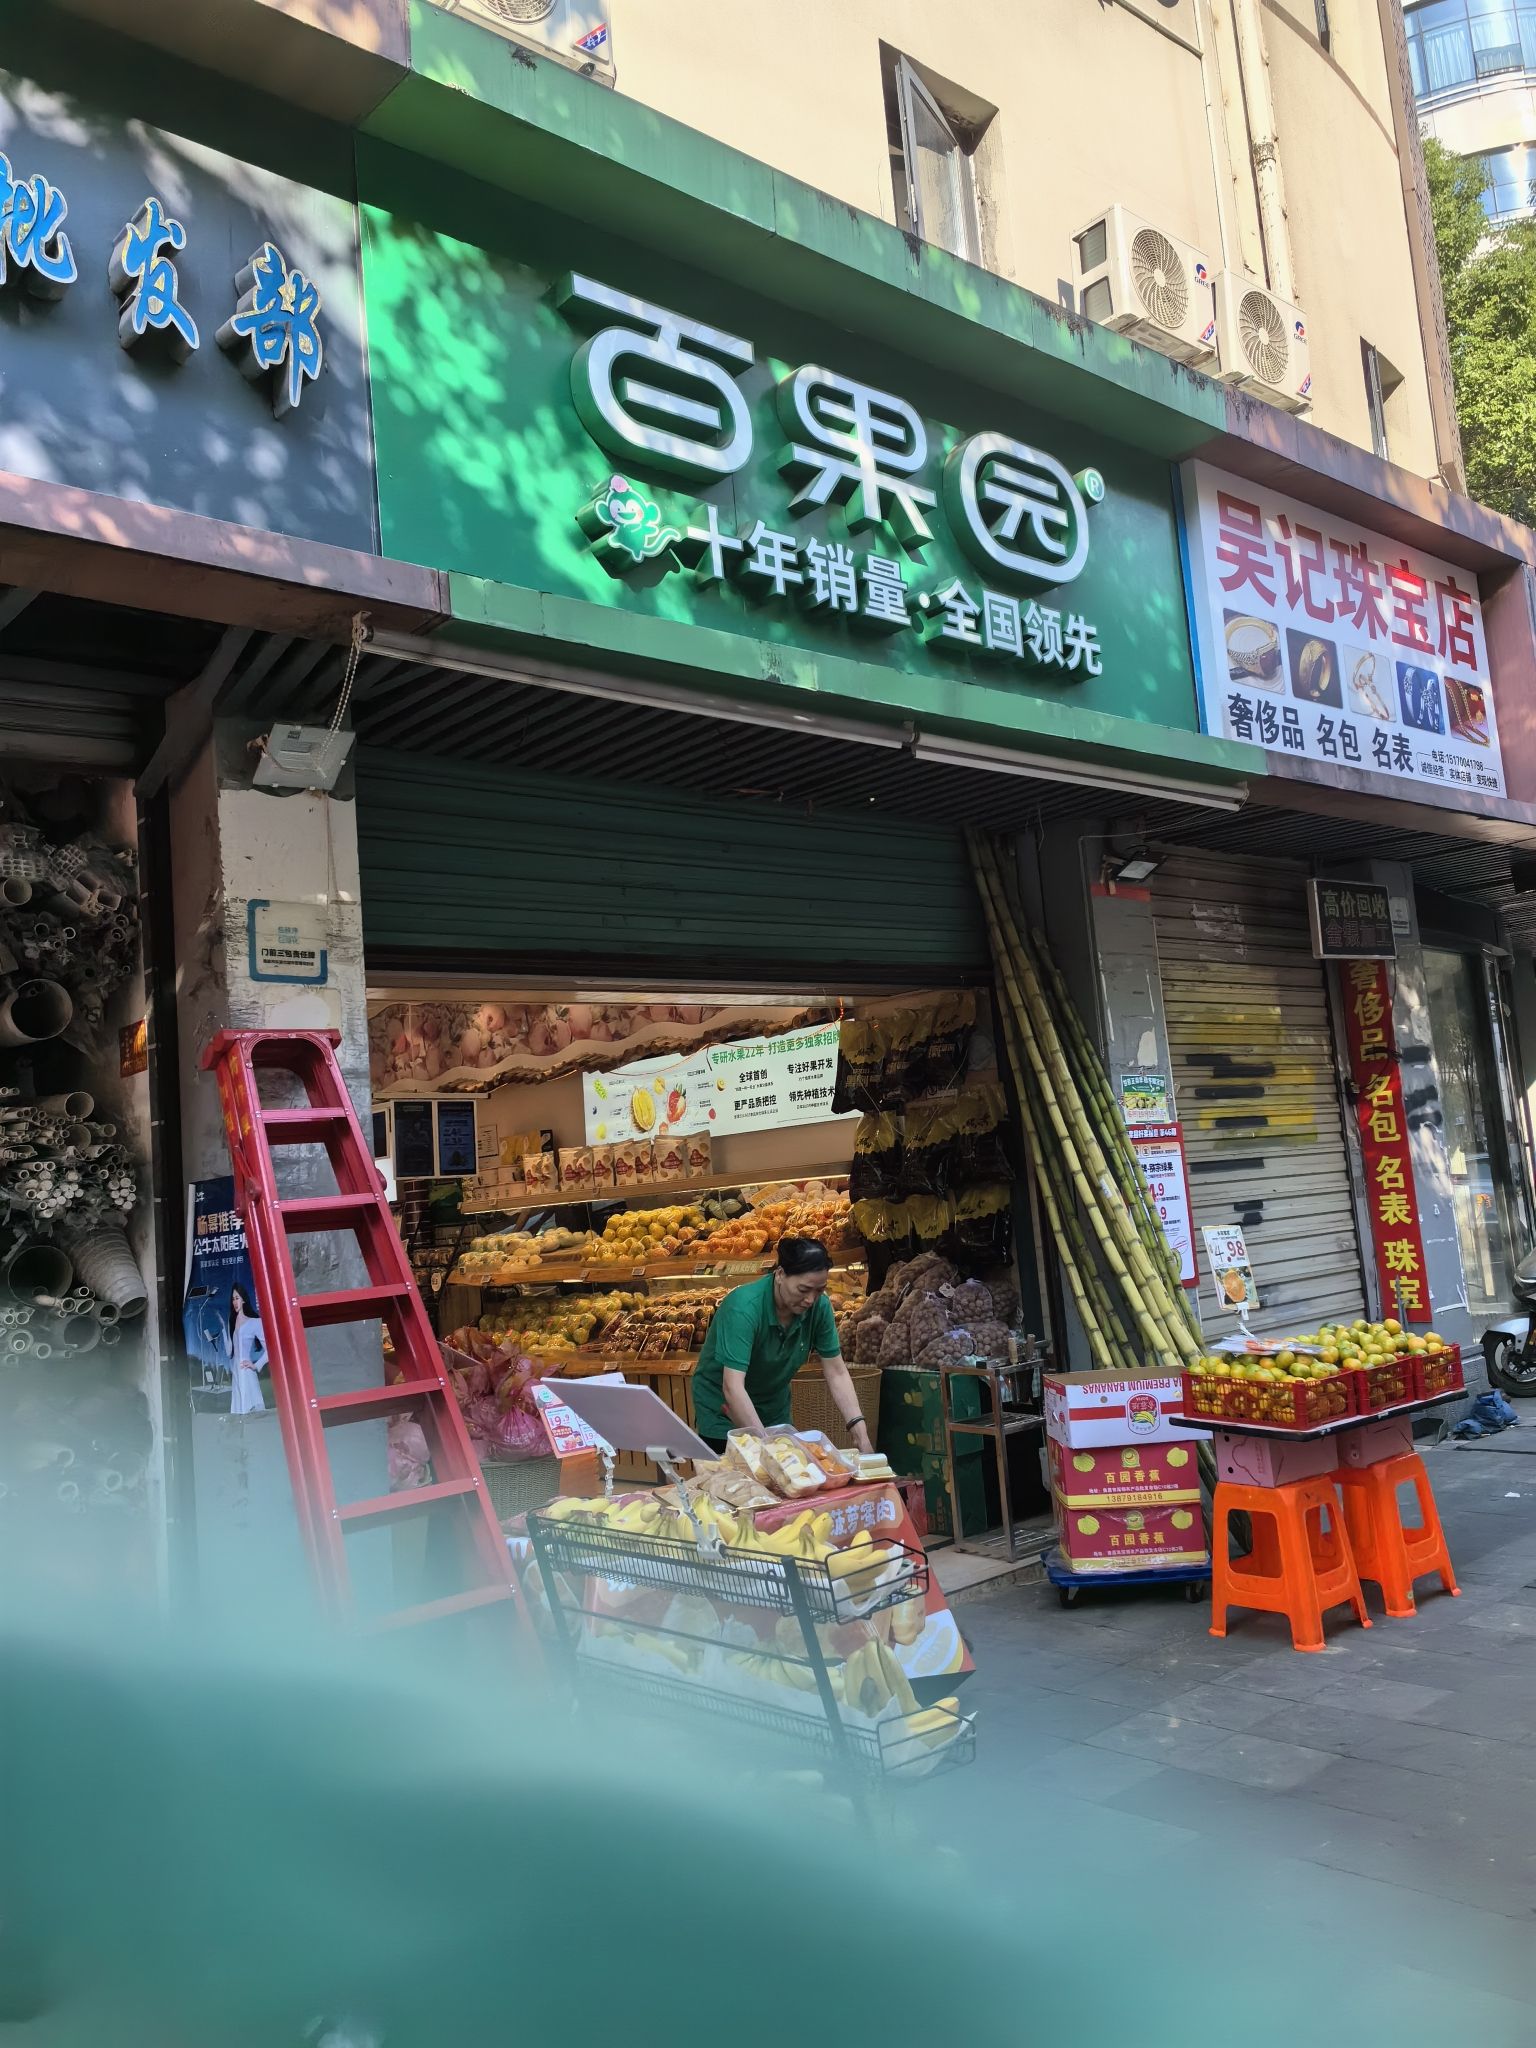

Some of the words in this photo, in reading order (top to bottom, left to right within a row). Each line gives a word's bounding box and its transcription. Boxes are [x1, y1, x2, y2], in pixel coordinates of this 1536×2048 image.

[571, 271, 1090, 584] 百果园
[1216, 490, 1478, 672] 吴记珠宝店
[1227, 692, 1305, 751] 奢侈品
[1316, 713, 1362, 763] 名包
[1371, 727, 1415, 774] 名表
[1350, 959, 1389, 1063] 奢侈品
[738, 1068, 769, 1084] 全球首创
[787, 1057, 834, 1075] 专注好果开发
[1365, 1074, 1402, 1144] 名包
[1375, 1155, 1413, 1226] 名表
[1384, 1238, 1425, 1310] 珠宝
[1083, 1381, 1126, 1395] BANANAS
[1128, 1378, 1171, 1393] PREMIUM
[1104, 1470, 1161, 1484] 百园香蕉
[830, 1497, 896, 1537] 菠萝蜜肉
[1109, 1532, 1165, 1546] 百园香蕉
